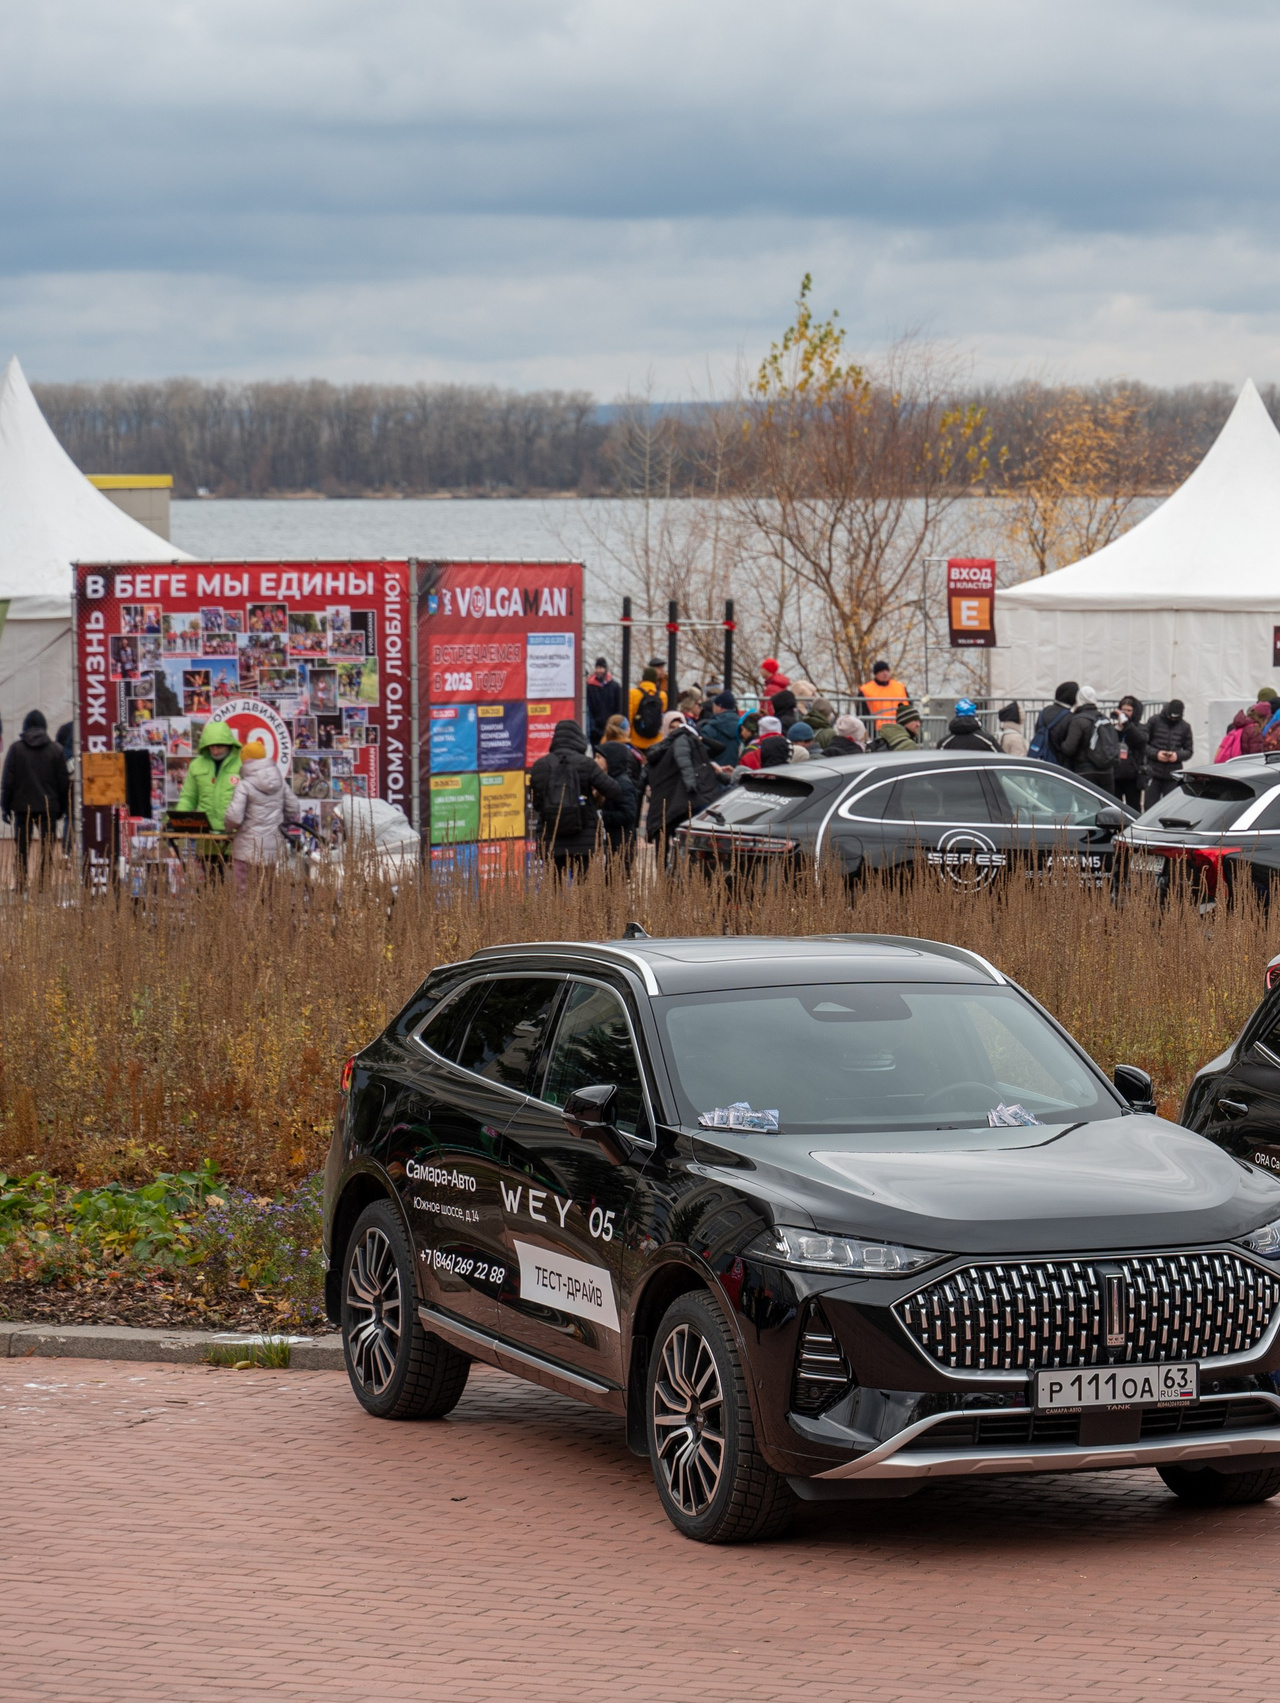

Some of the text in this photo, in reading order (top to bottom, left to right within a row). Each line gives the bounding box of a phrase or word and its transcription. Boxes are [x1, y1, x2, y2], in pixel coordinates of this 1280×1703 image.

[86, 571, 374, 600] В БЕГЕ МЫ ЕДИНЫ
[950, 568, 992, 582] ВХОД
[455, 586, 567, 617] VOLGAMAN
[961, 600, 979, 626] E
[384, 573, 403, 676] ЛЮБЛЮ!
[433, 643, 521, 665] ВСТРЕЧАЕМСЯ
[85, 610, 107, 726] ЖИЗНЬ
[433, 673, 442, 692] В
[444, 672, 473, 692] 2025
[475, 671, 507, 693] ГОДУ
[386, 682, 403, 730] ЧТО
[242, 701, 290, 764] ДВИЖЕНИЮ
[928, 853, 1006, 866] SERES
[1082, 856, 1101, 868] M5
[1255, 1152, 1270, 1167] ORA
[406, 1159, 476, 1192] Самара-Авто
[413, 1196, 441, 1213] Южное
[440, 1204, 465, 1221] шоссе,
[500, 1180, 616, 1242] WEY 05
[420, 1248, 432, 1265] +7
[454, 1257, 474, 1275] 269
[474, 1262, 489, 1280] 22
[489, 1266, 506, 1284] 88
[535, 1265, 603, 1307] ТЕСТ-ДРАЙВ
[1163, 1367, 1188, 1389] 63
[1160, 1389, 1180, 1398] RUS
